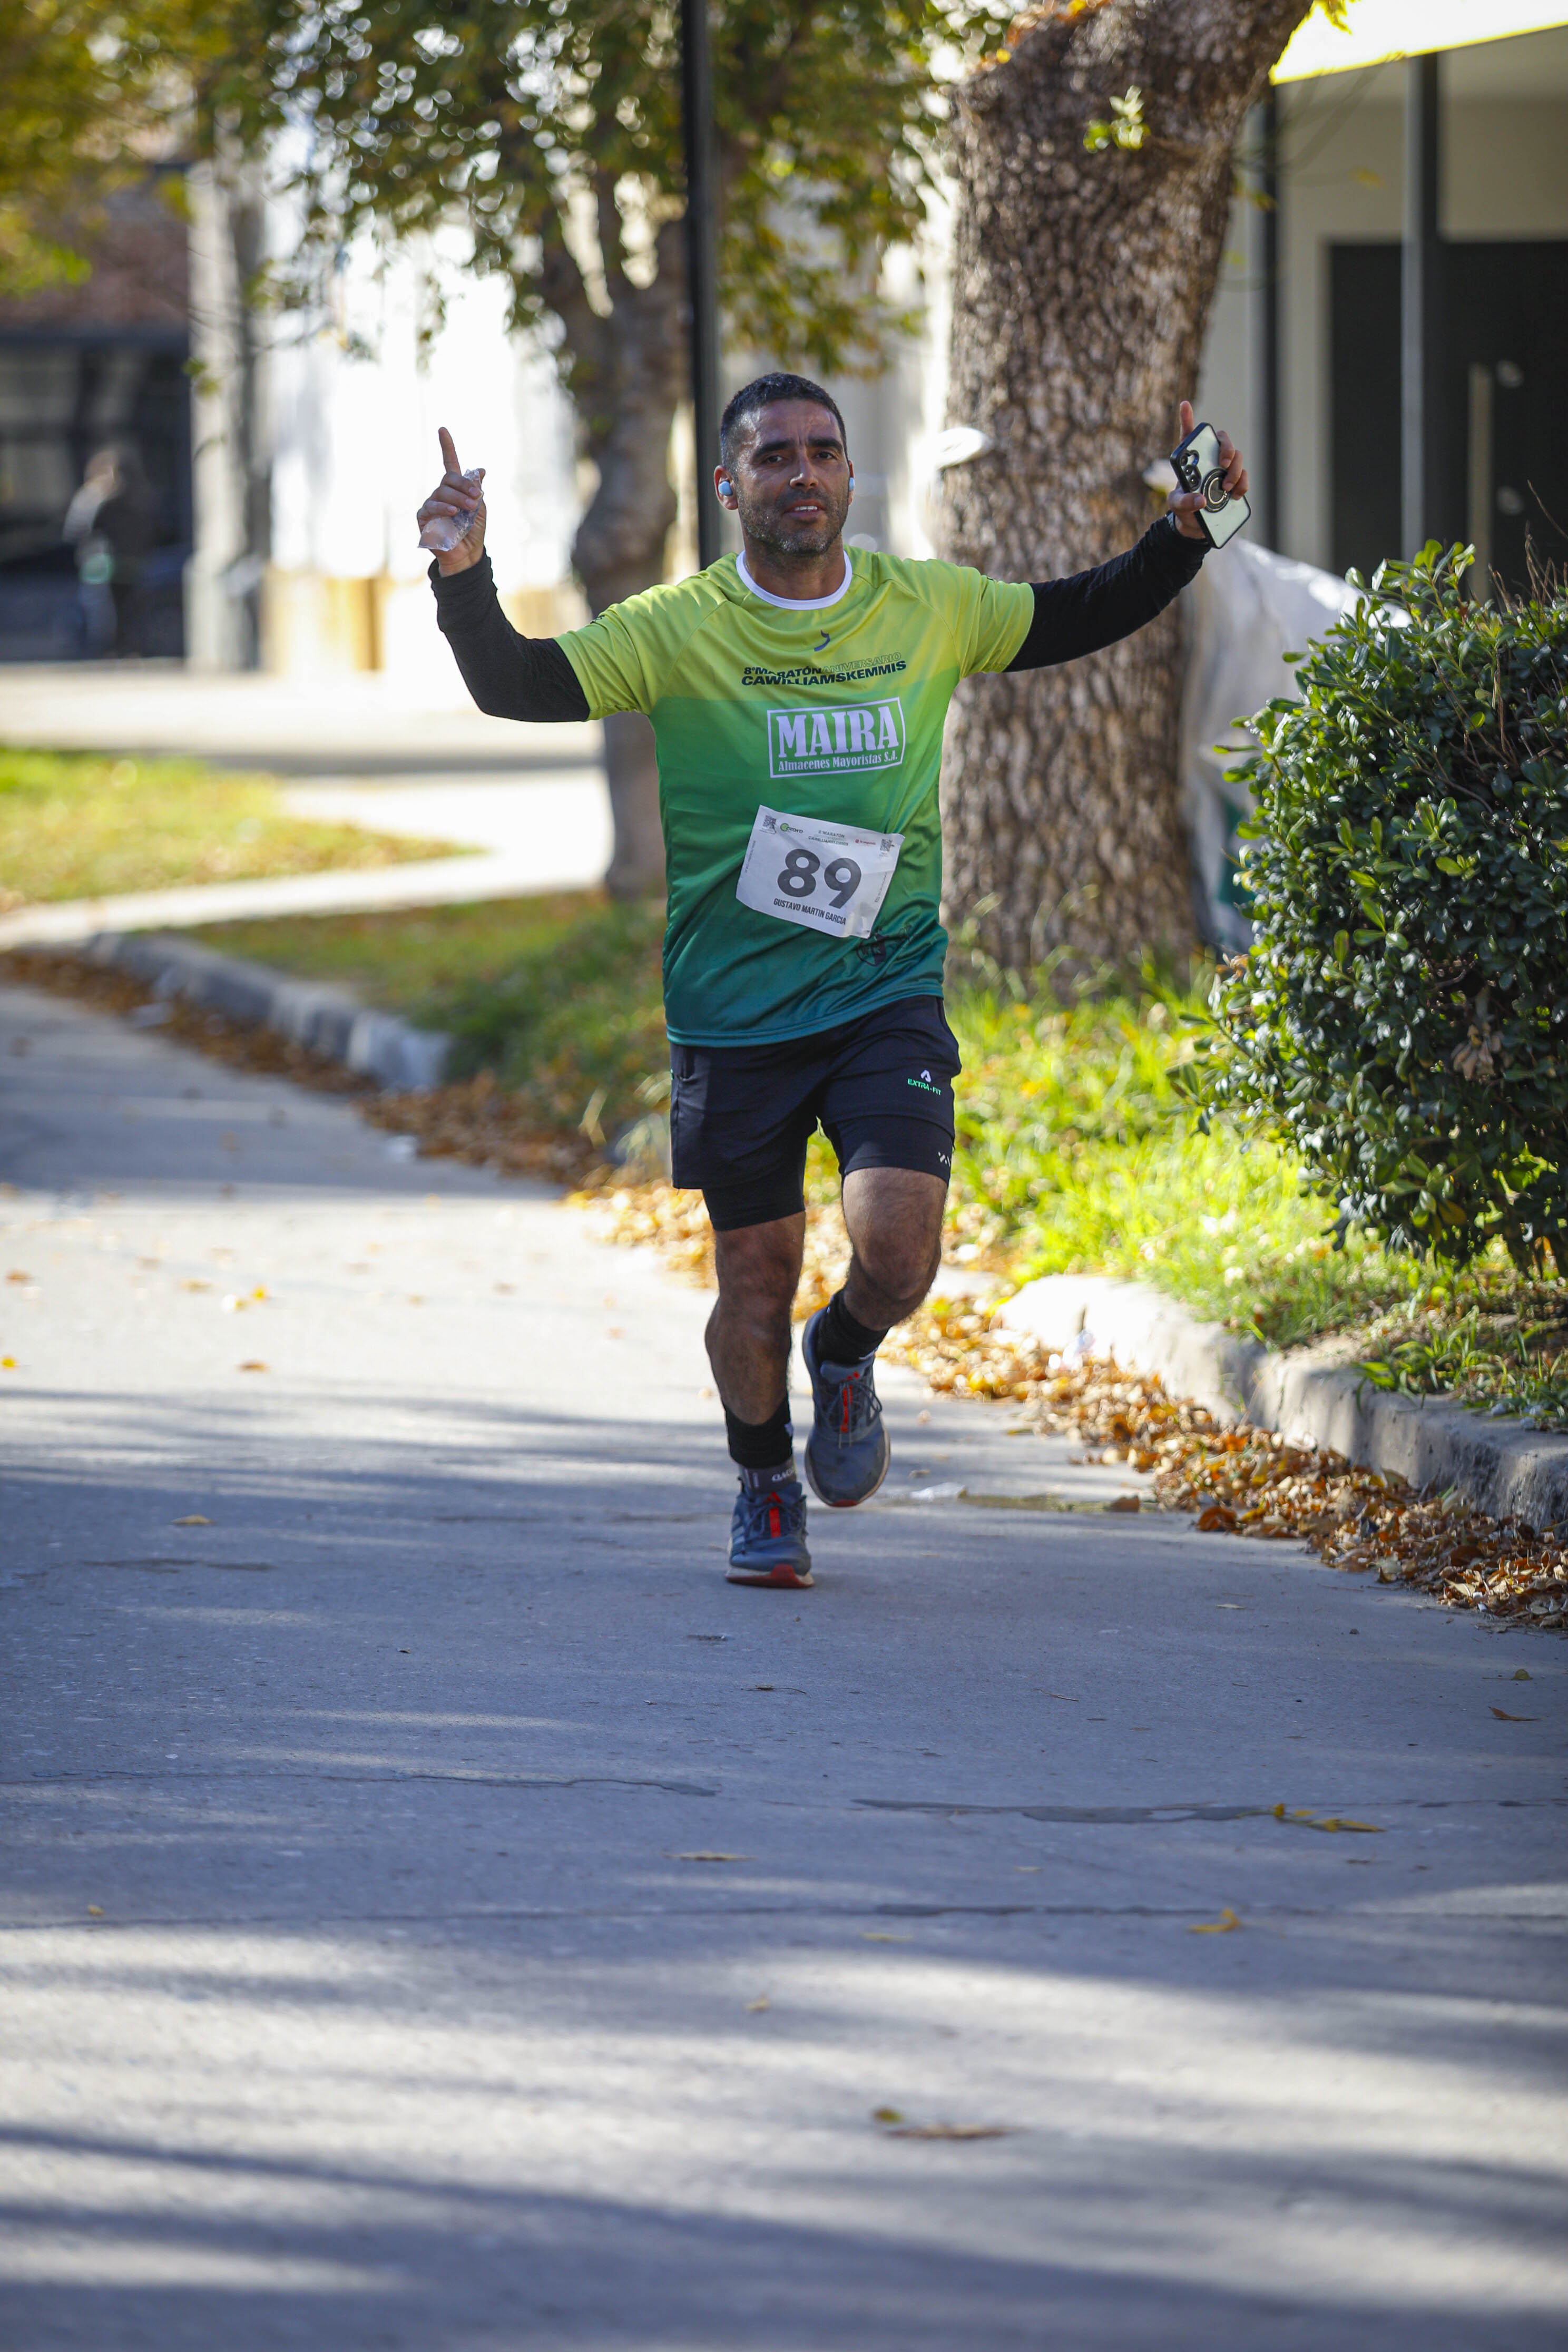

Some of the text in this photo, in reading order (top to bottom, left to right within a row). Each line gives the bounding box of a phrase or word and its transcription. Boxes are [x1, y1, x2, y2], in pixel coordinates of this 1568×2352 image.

[822, 652, 901, 672] ANIVERSARIO
[776, 705, 899, 758] MAIRA
[778, 750, 898, 772] Almacenes Mayoristas S.A.
[777, 848, 861, 909] 89
[773, 898, 847, 925] GUSTAVO MARTIN GARCIA
